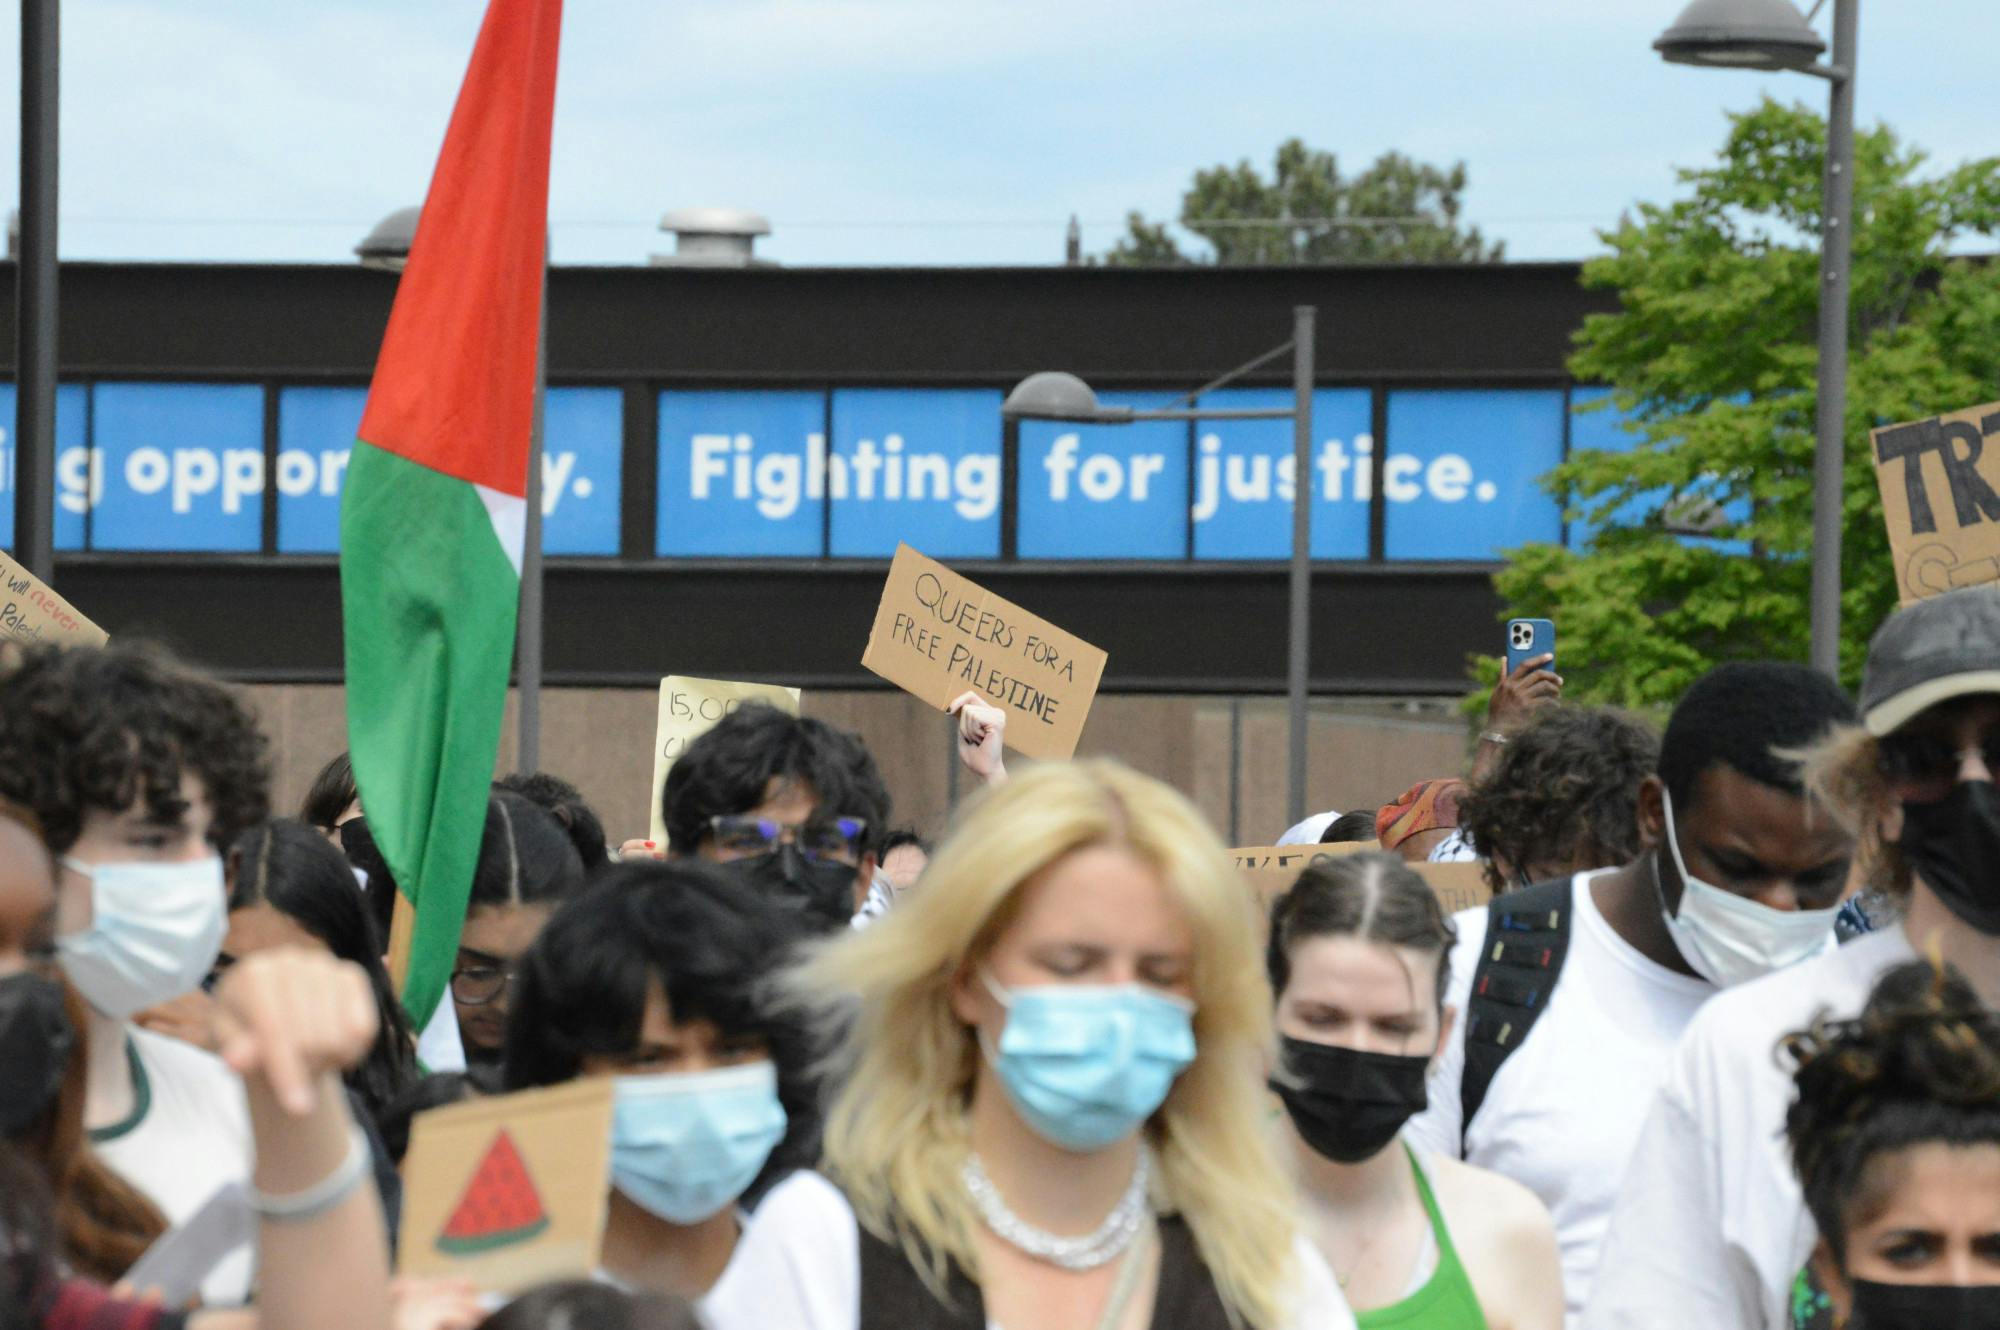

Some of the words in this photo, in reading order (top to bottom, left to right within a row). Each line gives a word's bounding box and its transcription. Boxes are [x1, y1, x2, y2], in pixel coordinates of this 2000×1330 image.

[690, 433, 1000, 521] Fighting
[1043, 433, 1165, 501] for
[30, 590, 81, 632] never
[915, 573, 1017, 648] QUEERS
[1023, 635, 1060, 670] FOR
[1058, 659, 1073, 683] A
[892, 612, 942, 661] FREE
[947, 643, 1060, 725] PALESTINE
